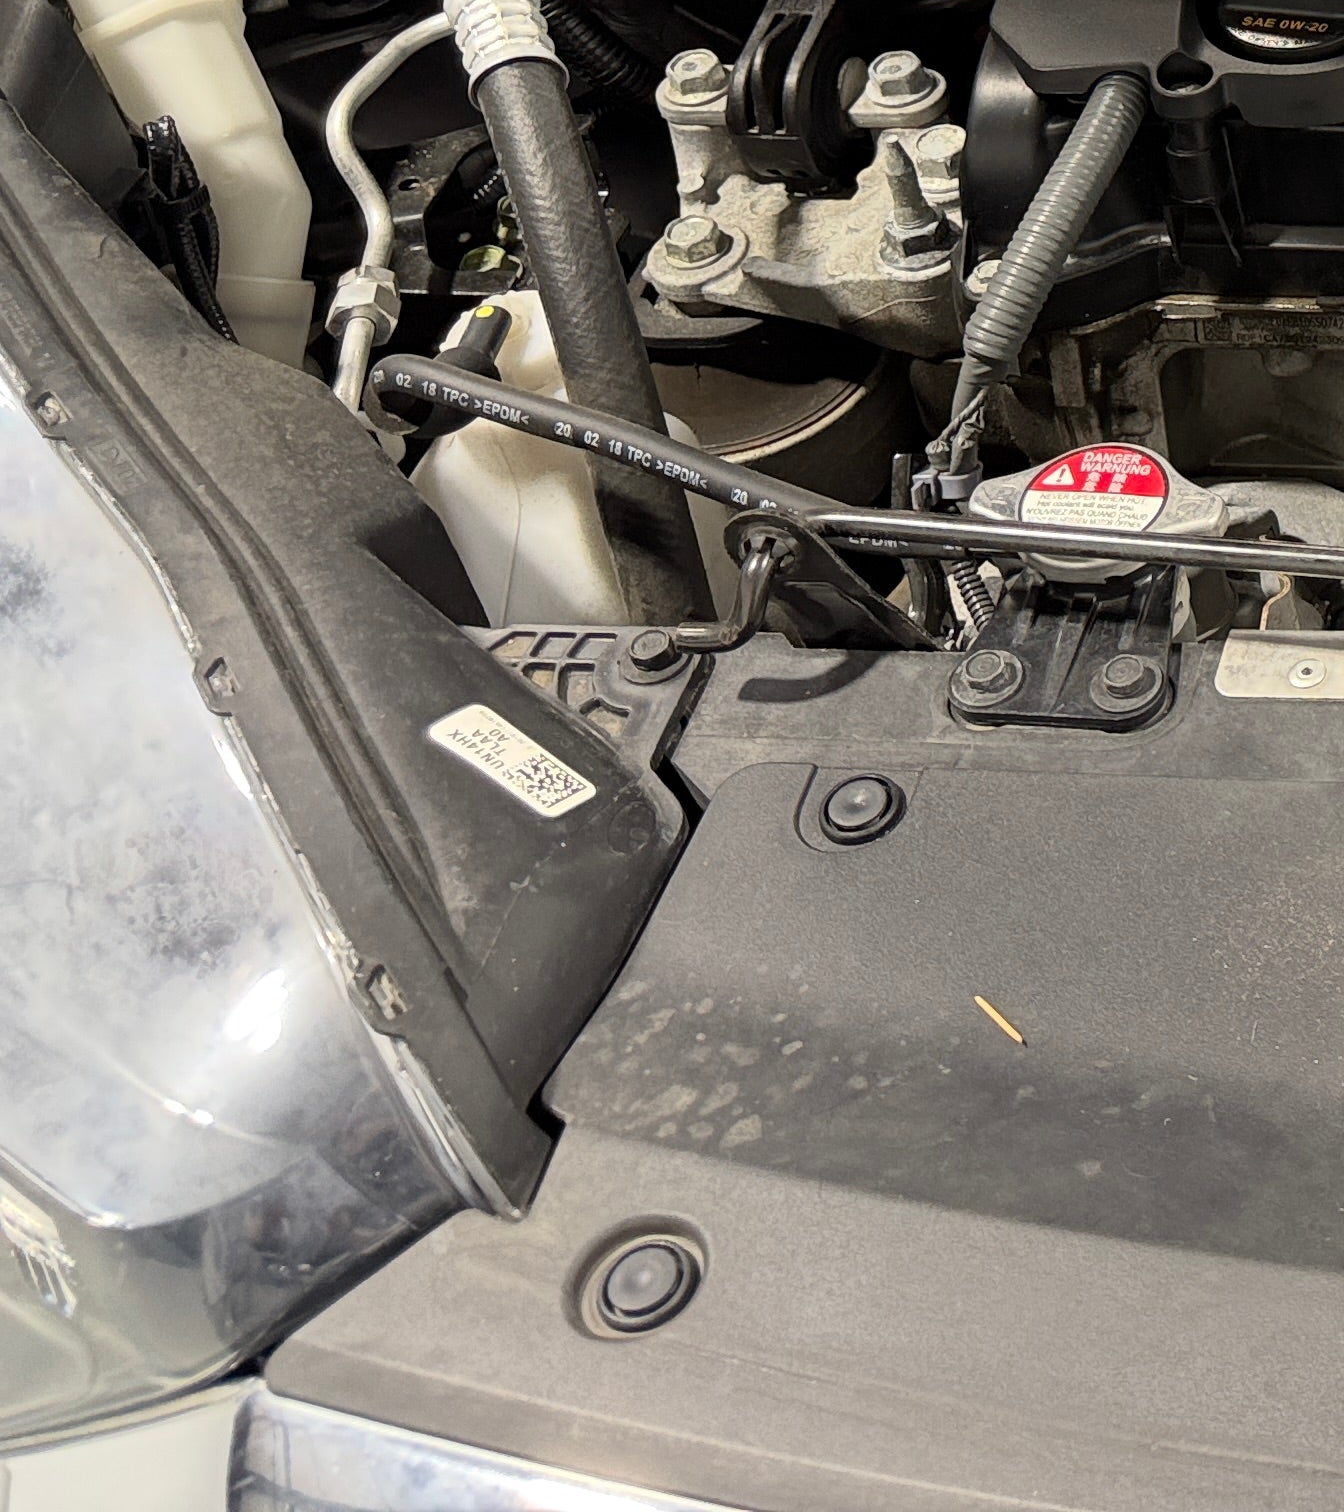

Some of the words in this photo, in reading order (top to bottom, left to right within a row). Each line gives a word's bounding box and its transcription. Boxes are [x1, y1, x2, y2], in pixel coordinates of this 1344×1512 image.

[1242, 16, 1277, 28] SAE
[1279, 20, 1329, 33] 0W-20
[395, 372, 412, 389] 02
[421, 380, 437, 397] 18
[442, 386, 469, 407] TPC
[583, 430, 600, 447] 02
[608, 439, 623, 456] 18
[627, 445, 653, 468] TPC
[1083, 451, 1143, 465] DANGER
[1080, 461, 1152, 476] WARNUNG
[1087, 510, 1116, 519] QUAND
[471, 729, 507, 756] TLAA
